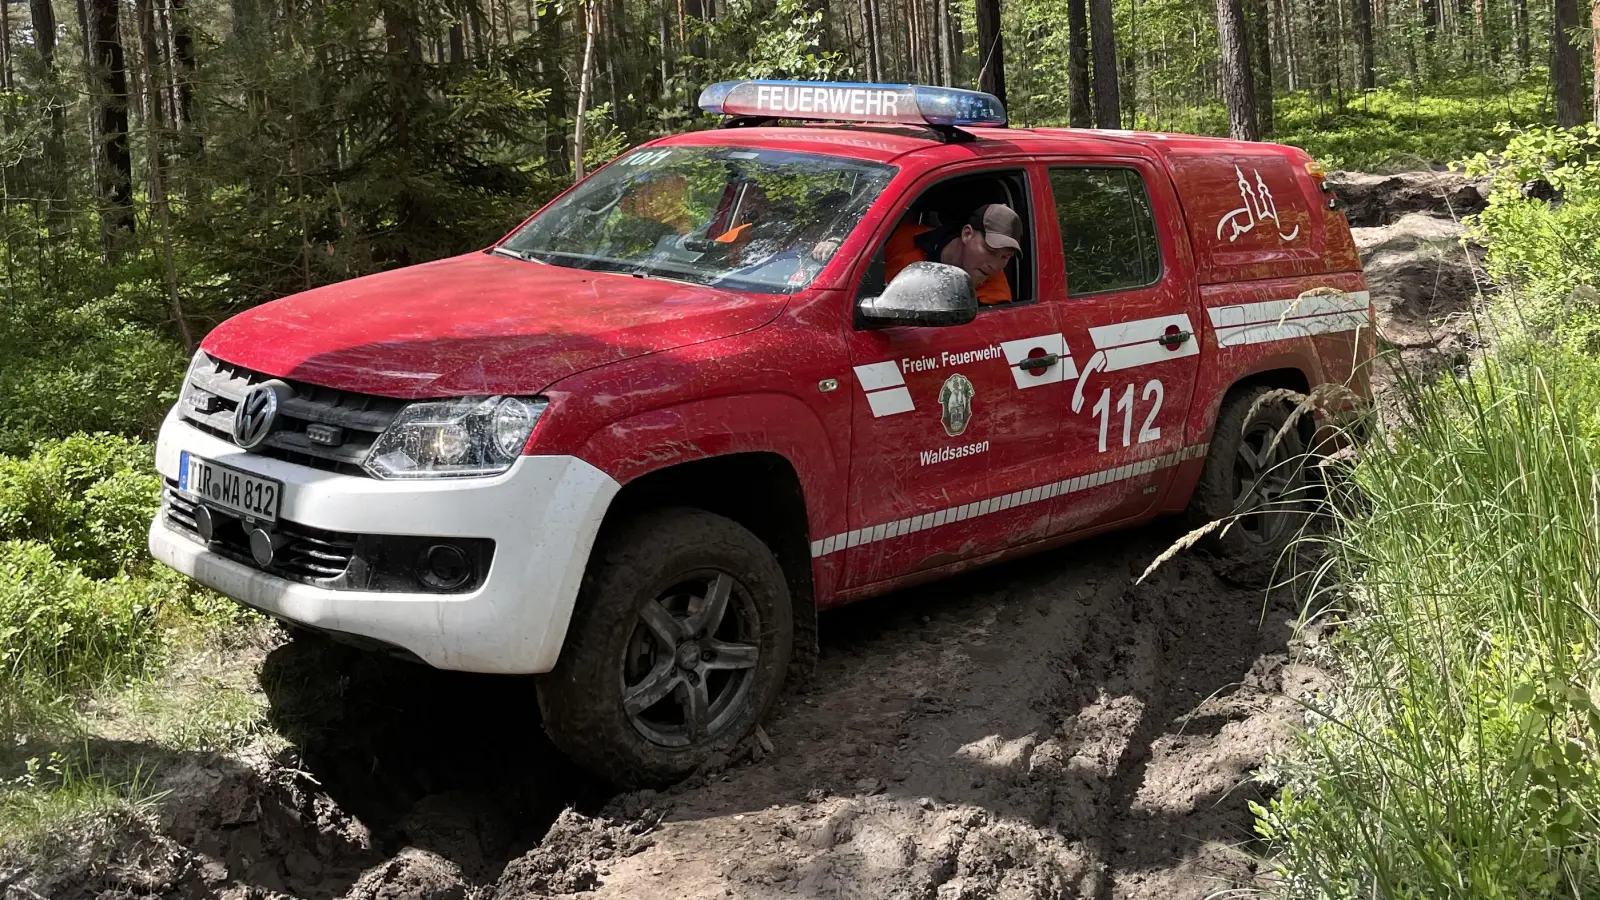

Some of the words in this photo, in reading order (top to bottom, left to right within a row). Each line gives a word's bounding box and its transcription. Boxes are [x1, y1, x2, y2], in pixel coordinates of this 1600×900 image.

[757, 86, 898, 116] FEUERWEHR
[902, 356, 939, 374] Freiw.
[942, 344, 1001, 367] Feuerwehr
[1092, 379, 1164, 453] 112
[920, 440, 989, 466] Waldsassen
[190, 460, 212, 496] TIR
[223, 472, 240, 506] WA
[244, 480, 274, 517] 812
